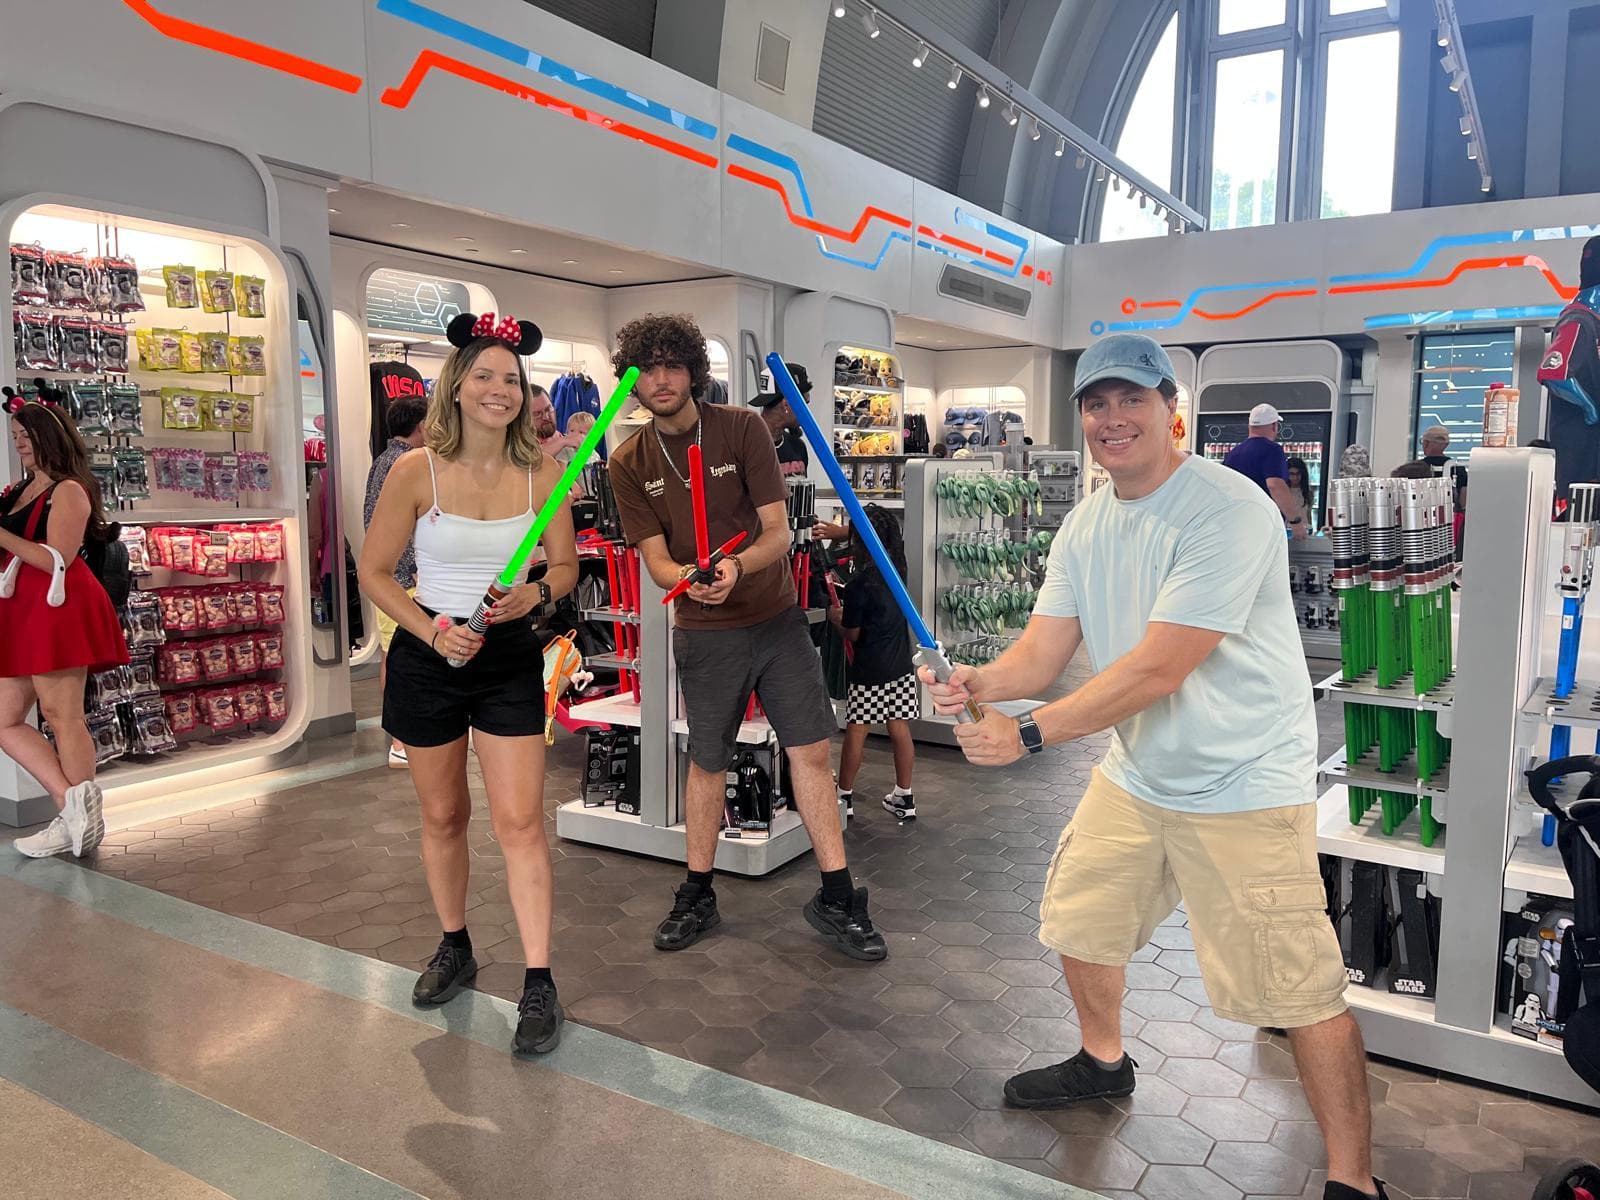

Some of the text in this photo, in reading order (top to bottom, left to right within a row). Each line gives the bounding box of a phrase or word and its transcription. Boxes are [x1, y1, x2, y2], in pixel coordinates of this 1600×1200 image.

[1345, 967, 1365, 979] TAR
[1395, 979, 1425, 989] STAR
[1395, 983, 1425, 993] WARS
